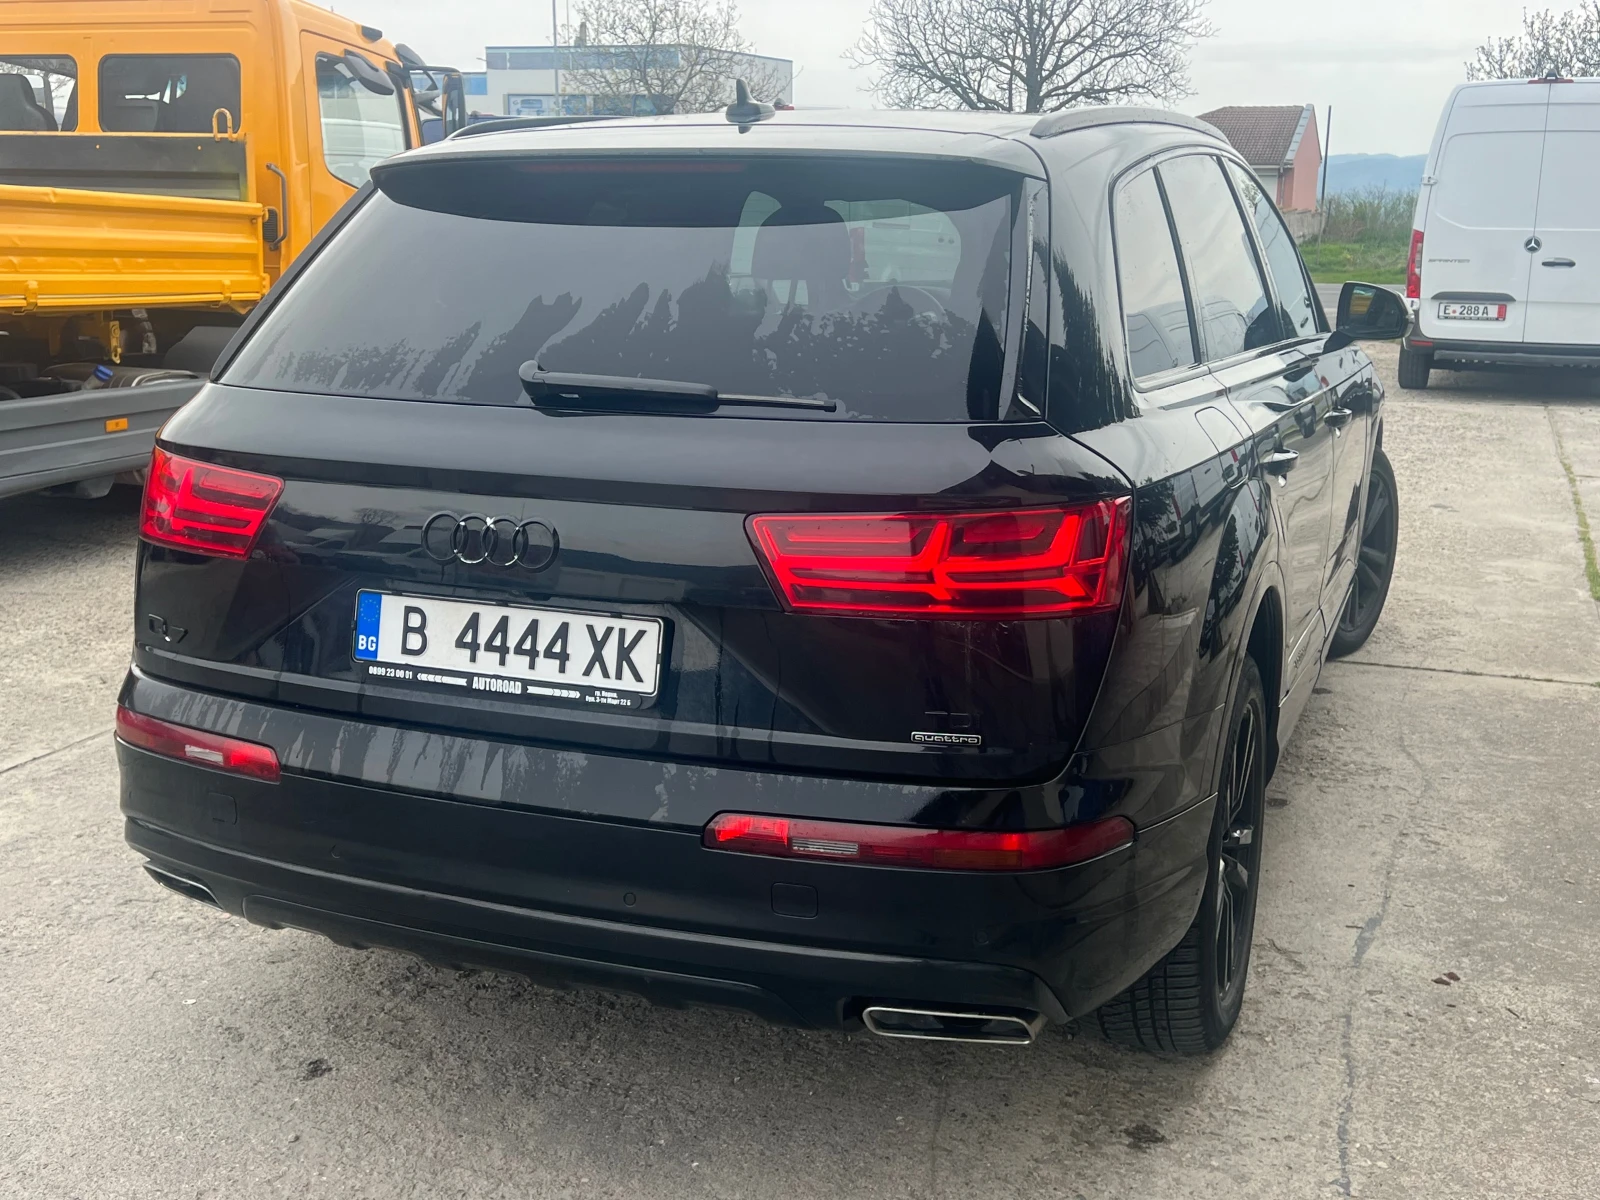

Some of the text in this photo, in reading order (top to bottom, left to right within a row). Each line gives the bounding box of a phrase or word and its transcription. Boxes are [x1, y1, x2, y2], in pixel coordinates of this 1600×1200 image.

[1443, 305, 1489, 316] E 288 A
[358, 635, 377, 651] BG
[400, 605, 648, 683] B 4444 XK
[386, 668, 395, 677] 23
[396, 669, 404, 678] 00
[405, 670, 413, 679] 01
[472, 676, 522, 695] AUTOROAD
[914, 734, 978, 744] quattro
